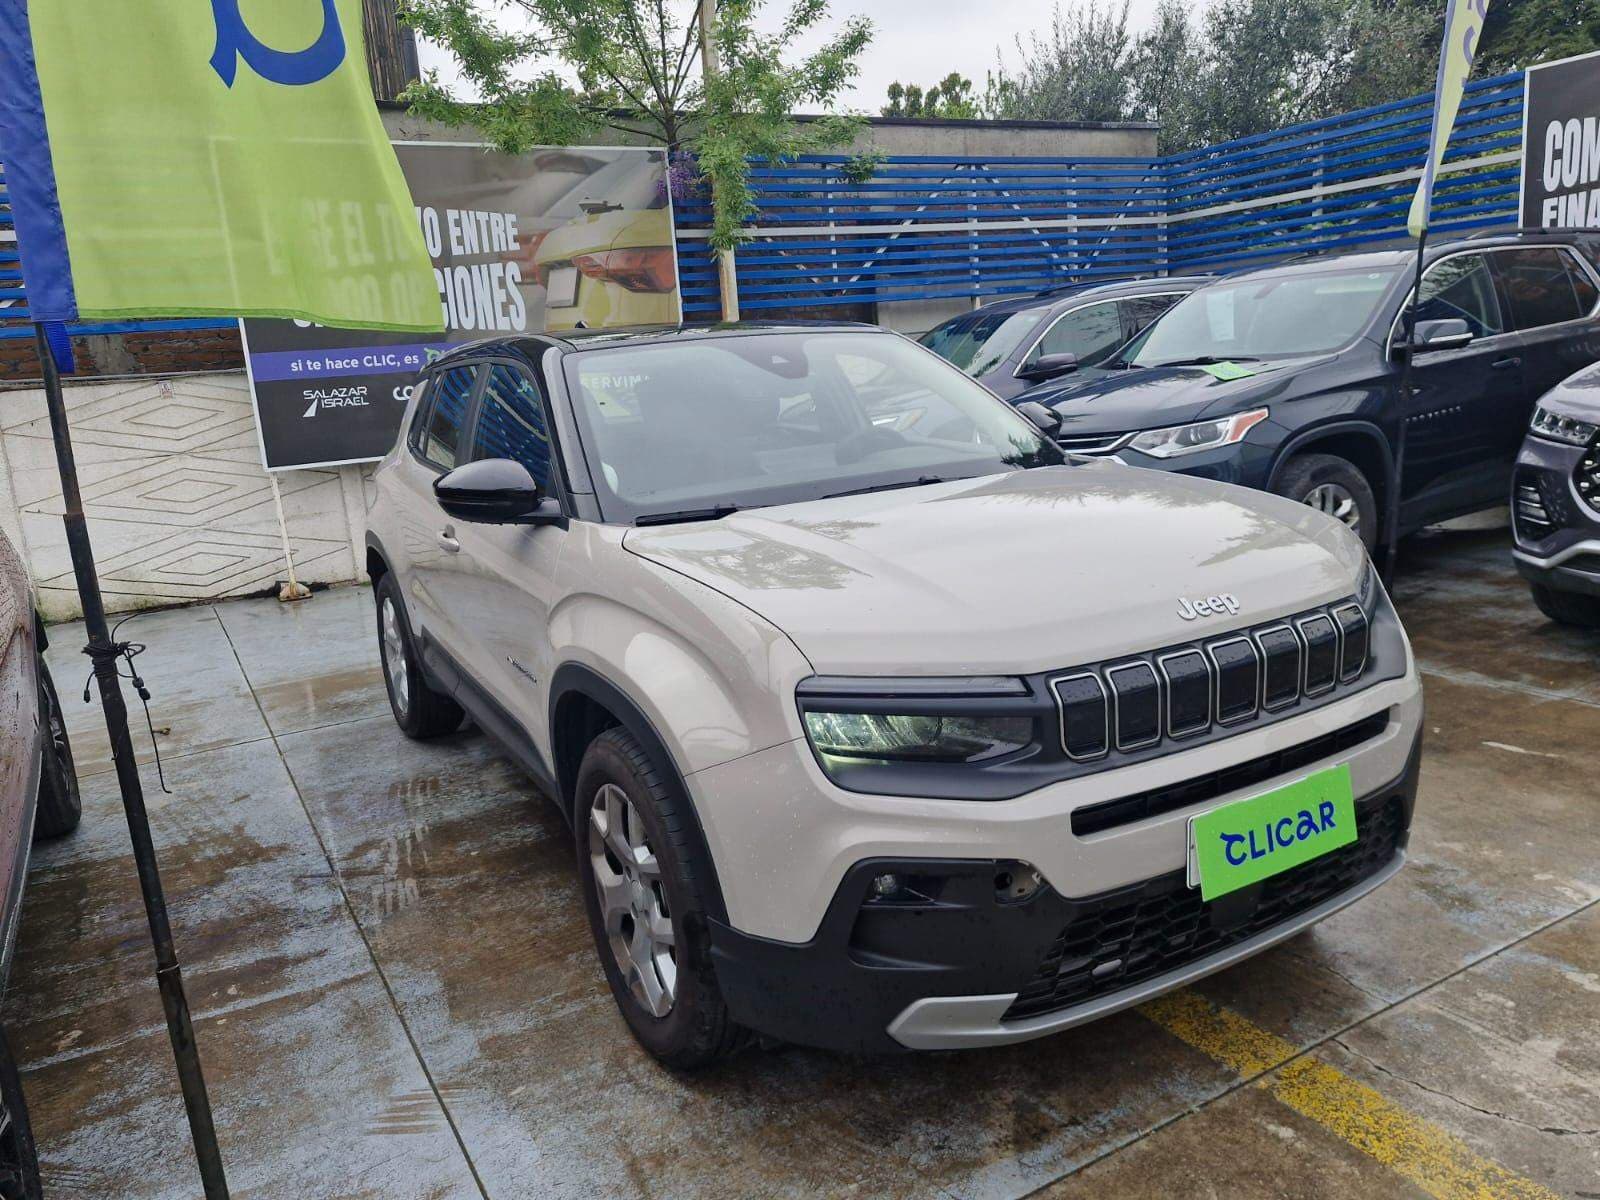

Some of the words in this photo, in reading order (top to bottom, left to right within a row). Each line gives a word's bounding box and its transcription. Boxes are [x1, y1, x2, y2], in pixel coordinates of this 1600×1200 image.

[446, 209, 520, 256] ENTRE
[291, 359, 301, 372] si
[306, 359, 321, 371] te
[325, 358, 359, 370] hace
[363, 354, 400, 367] CLIC,
[404, 355, 419, 364] es
[303, 386, 368, 400] SALAZAR
[321, 397, 370, 408] ISRAEL
[1176, 593, 1240, 621] Jeep
